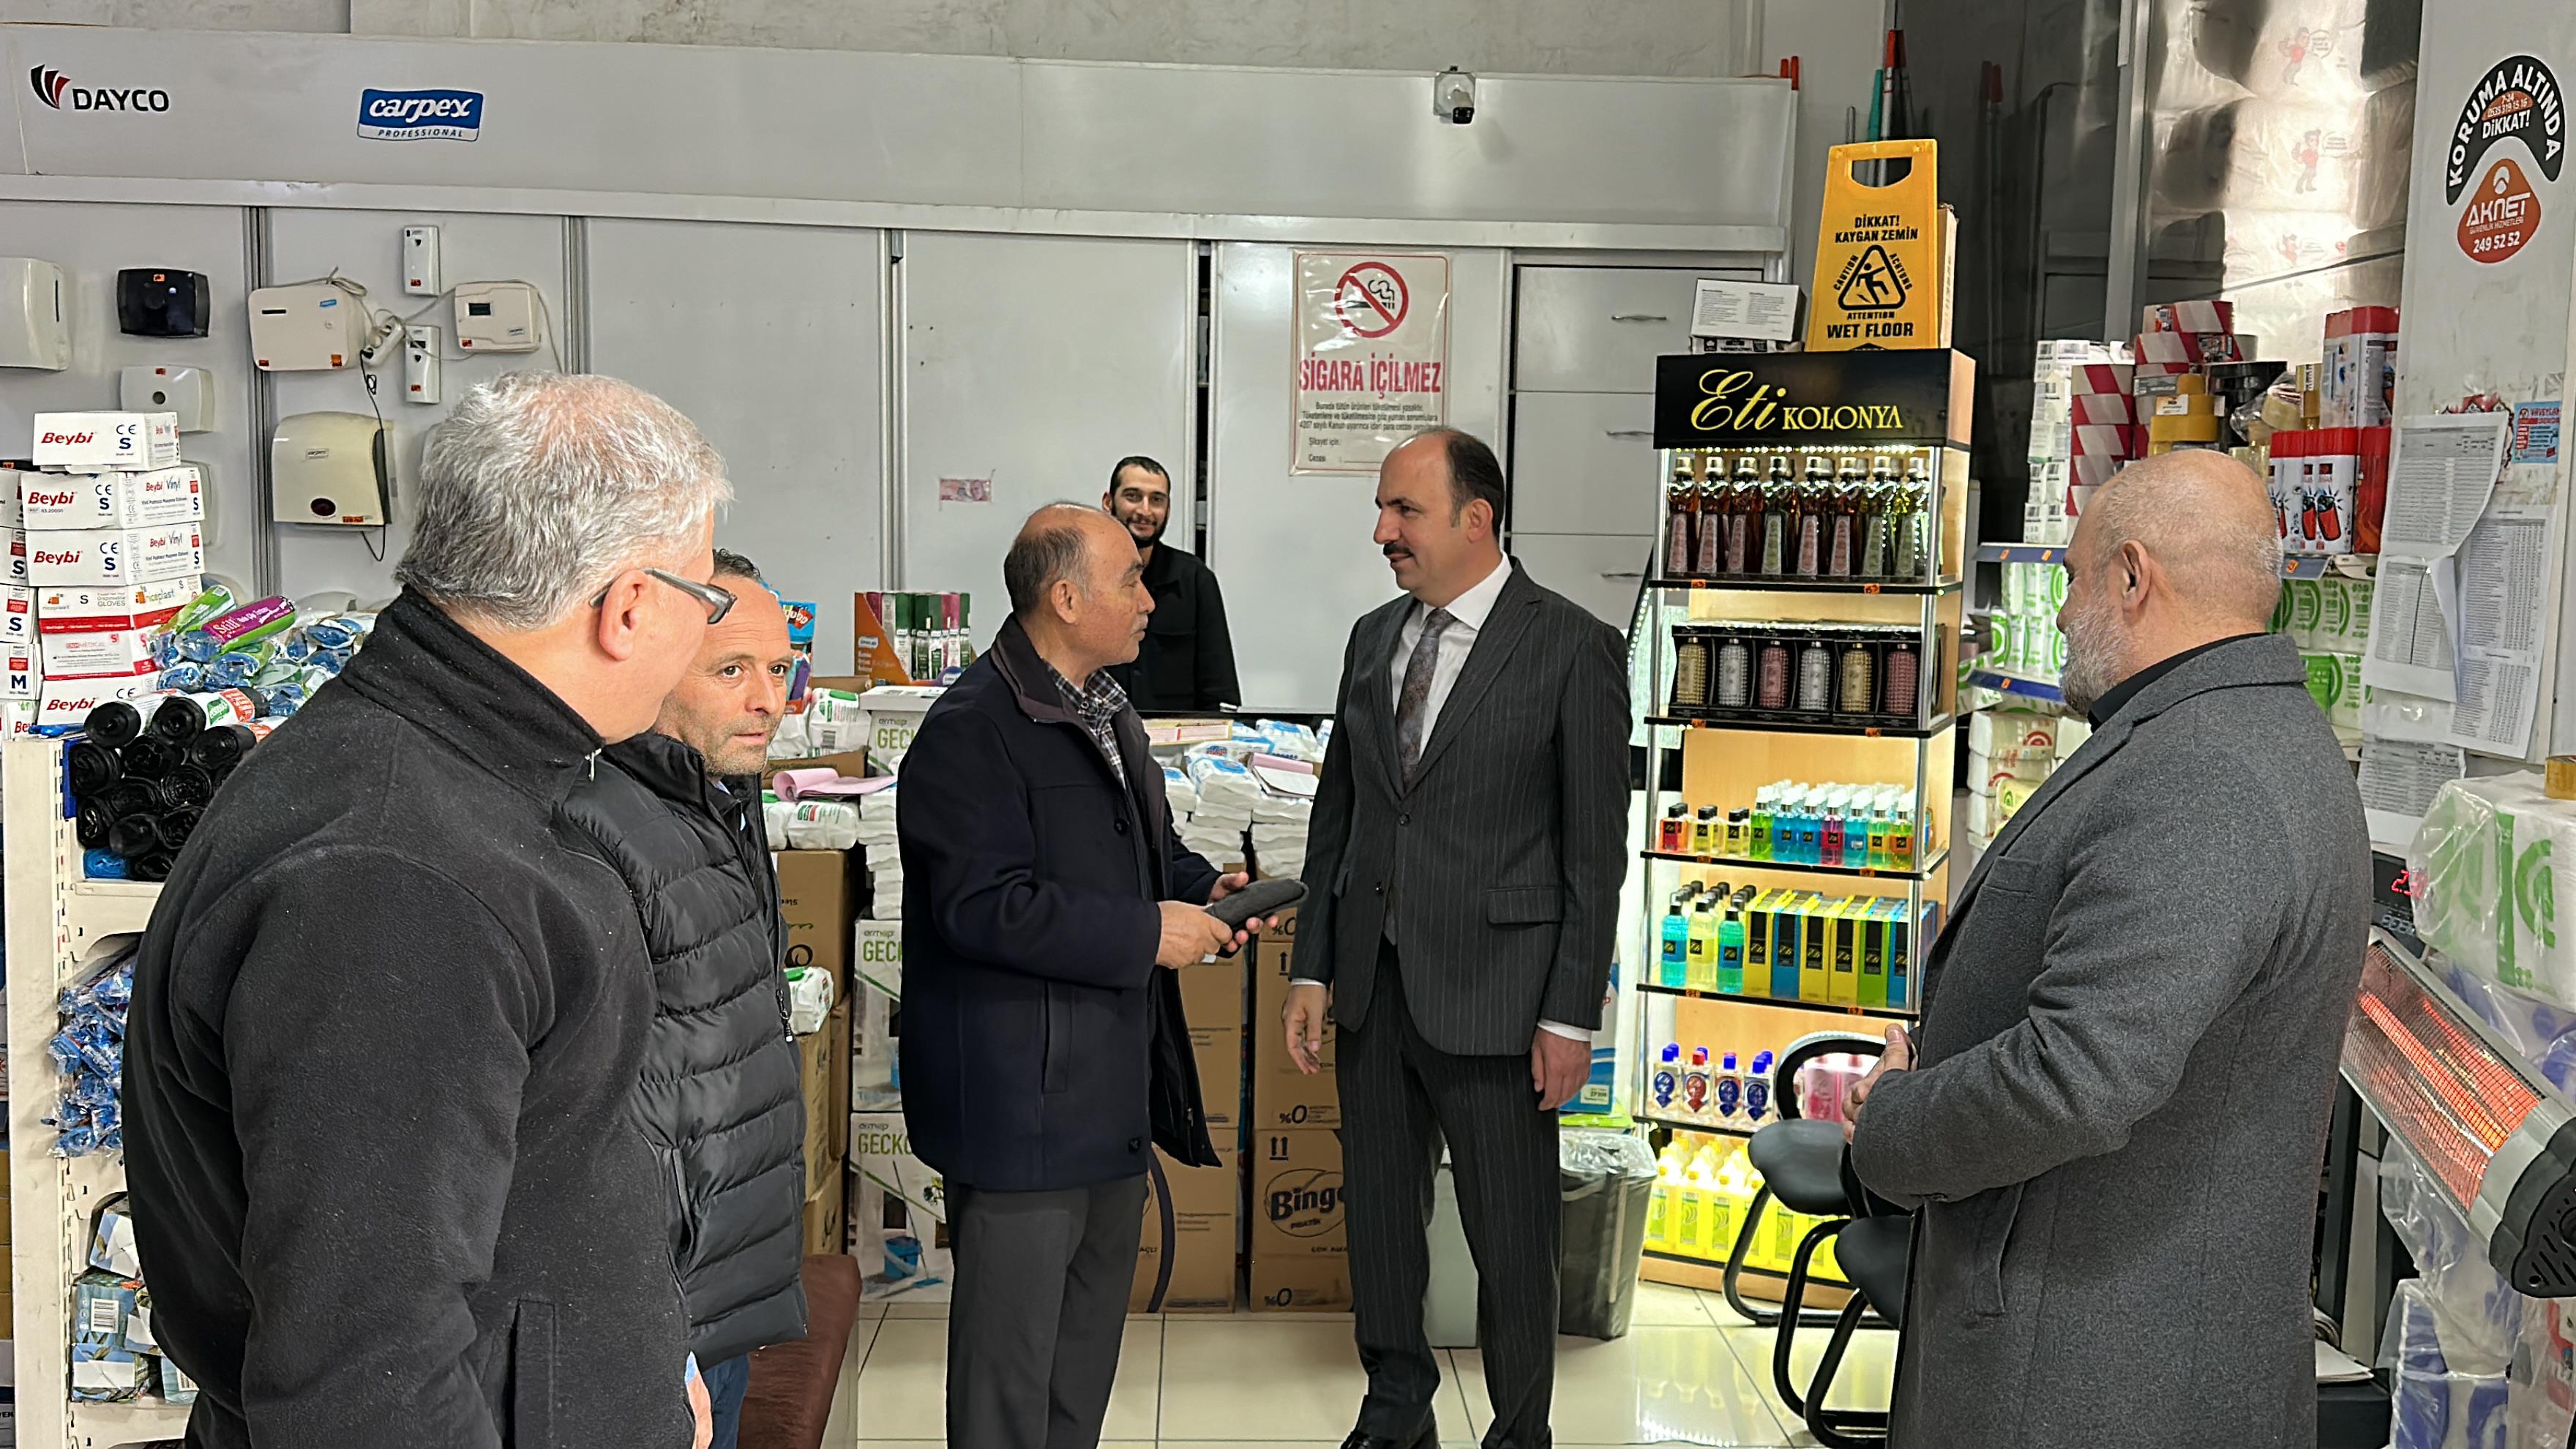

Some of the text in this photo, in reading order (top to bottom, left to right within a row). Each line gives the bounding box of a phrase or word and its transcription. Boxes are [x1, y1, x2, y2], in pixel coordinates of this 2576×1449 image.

[73, 88, 169, 111] DAYCO
[368, 97, 472, 123] carpex
[2449, 64, 2561, 187] KORUMA ALTINDA
[378, 129, 463, 138] PROFESSIONAL
[1854, 214, 1900, 228] DİKKAT!
[1835, 226, 1918, 243] KAYGAN ZEMİN
[2473, 231, 2520, 253] 249 52 52
[1833, 255, 1859, 291] CAUTION
[1847, 311, 1895, 321] ATTENTION
[1827, 322, 1914, 339] WET FLOOR
[1299, 351, 1441, 399] SİGARA İÇİLMEZ
[1690, 368, 1903, 433] Eti KOLONYA
[41, 432, 94, 445] Beybi
[119, 437, 131, 449] S
[28, 492, 75, 506] Beybi
[100, 498, 110, 510] S
[34, 550, 80, 565] Beybi
[104, 557, 116, 571] S
[12, 560, 25, 574] S
[80, 595, 89, 604] S
[9, 617, 22, 632] S
[11, 675, 26, 689] M
[46, 697, 96, 711] Beybi
[877, 728, 916, 749] GEC
[863, 940, 902, 962] GEC
